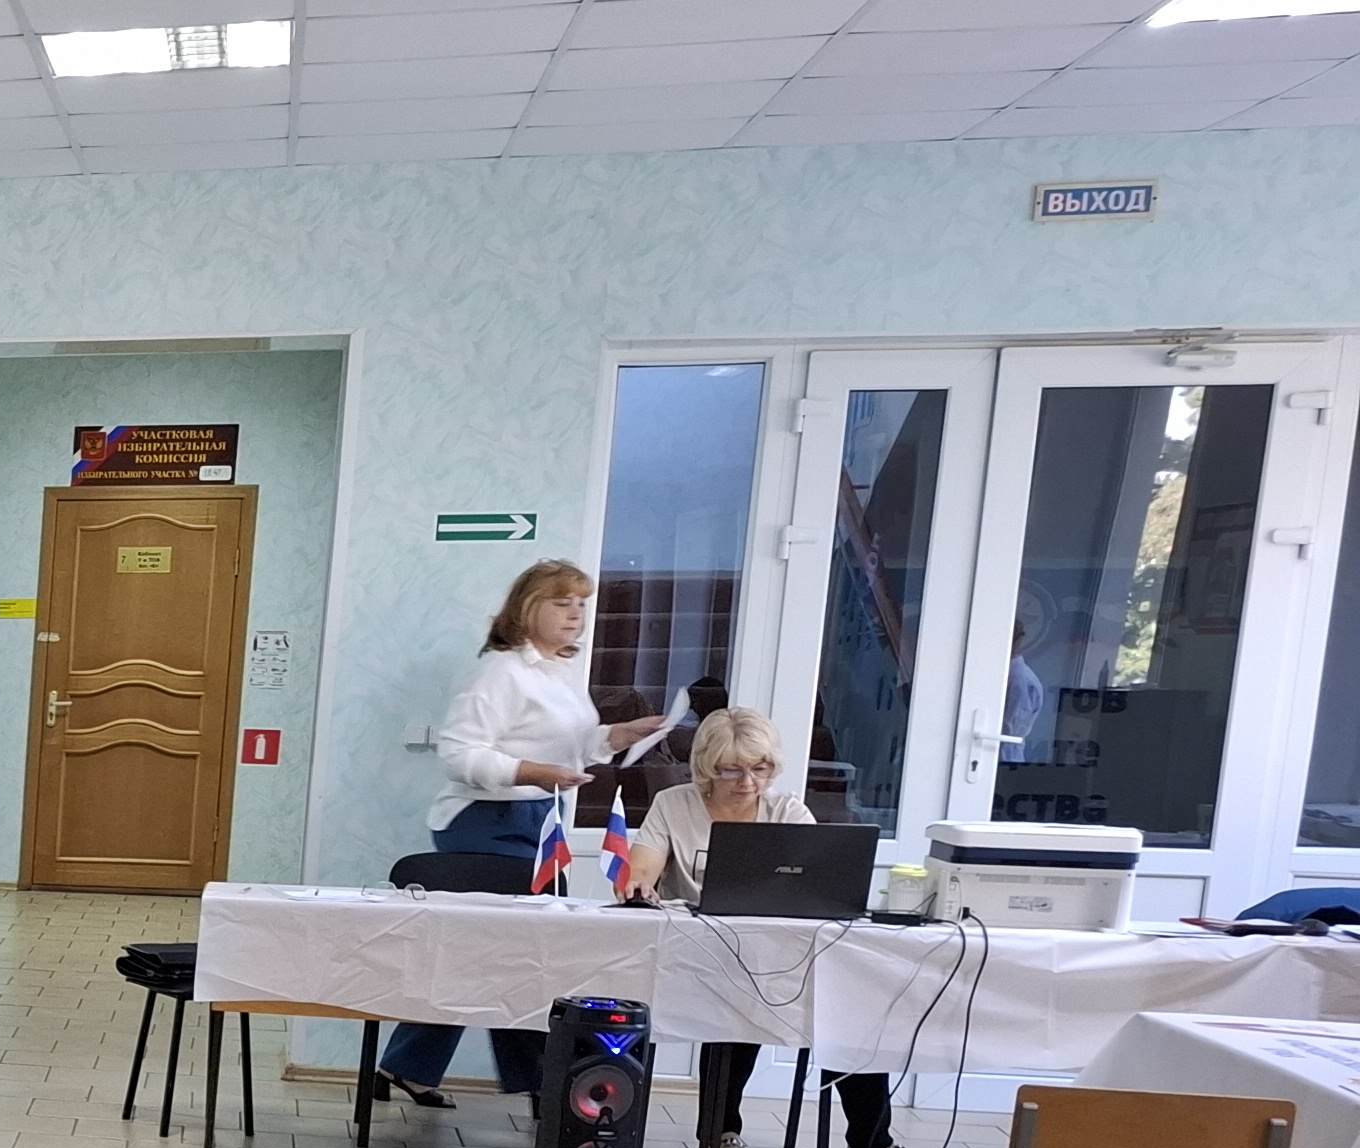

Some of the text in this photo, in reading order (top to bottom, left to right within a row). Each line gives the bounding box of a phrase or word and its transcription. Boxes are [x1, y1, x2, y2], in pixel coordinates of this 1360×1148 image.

[1047, 189, 1147, 213] ВЫХОД
[131, 429, 214, 440] УЧАСТКОВАЯ
[118, 441, 226, 452] ИЗБИРАТЕЛЬНАЯ
[135, 453, 207, 464] КОМИССИЯ
[151, 470, 186, 479] УЧАСТКА
